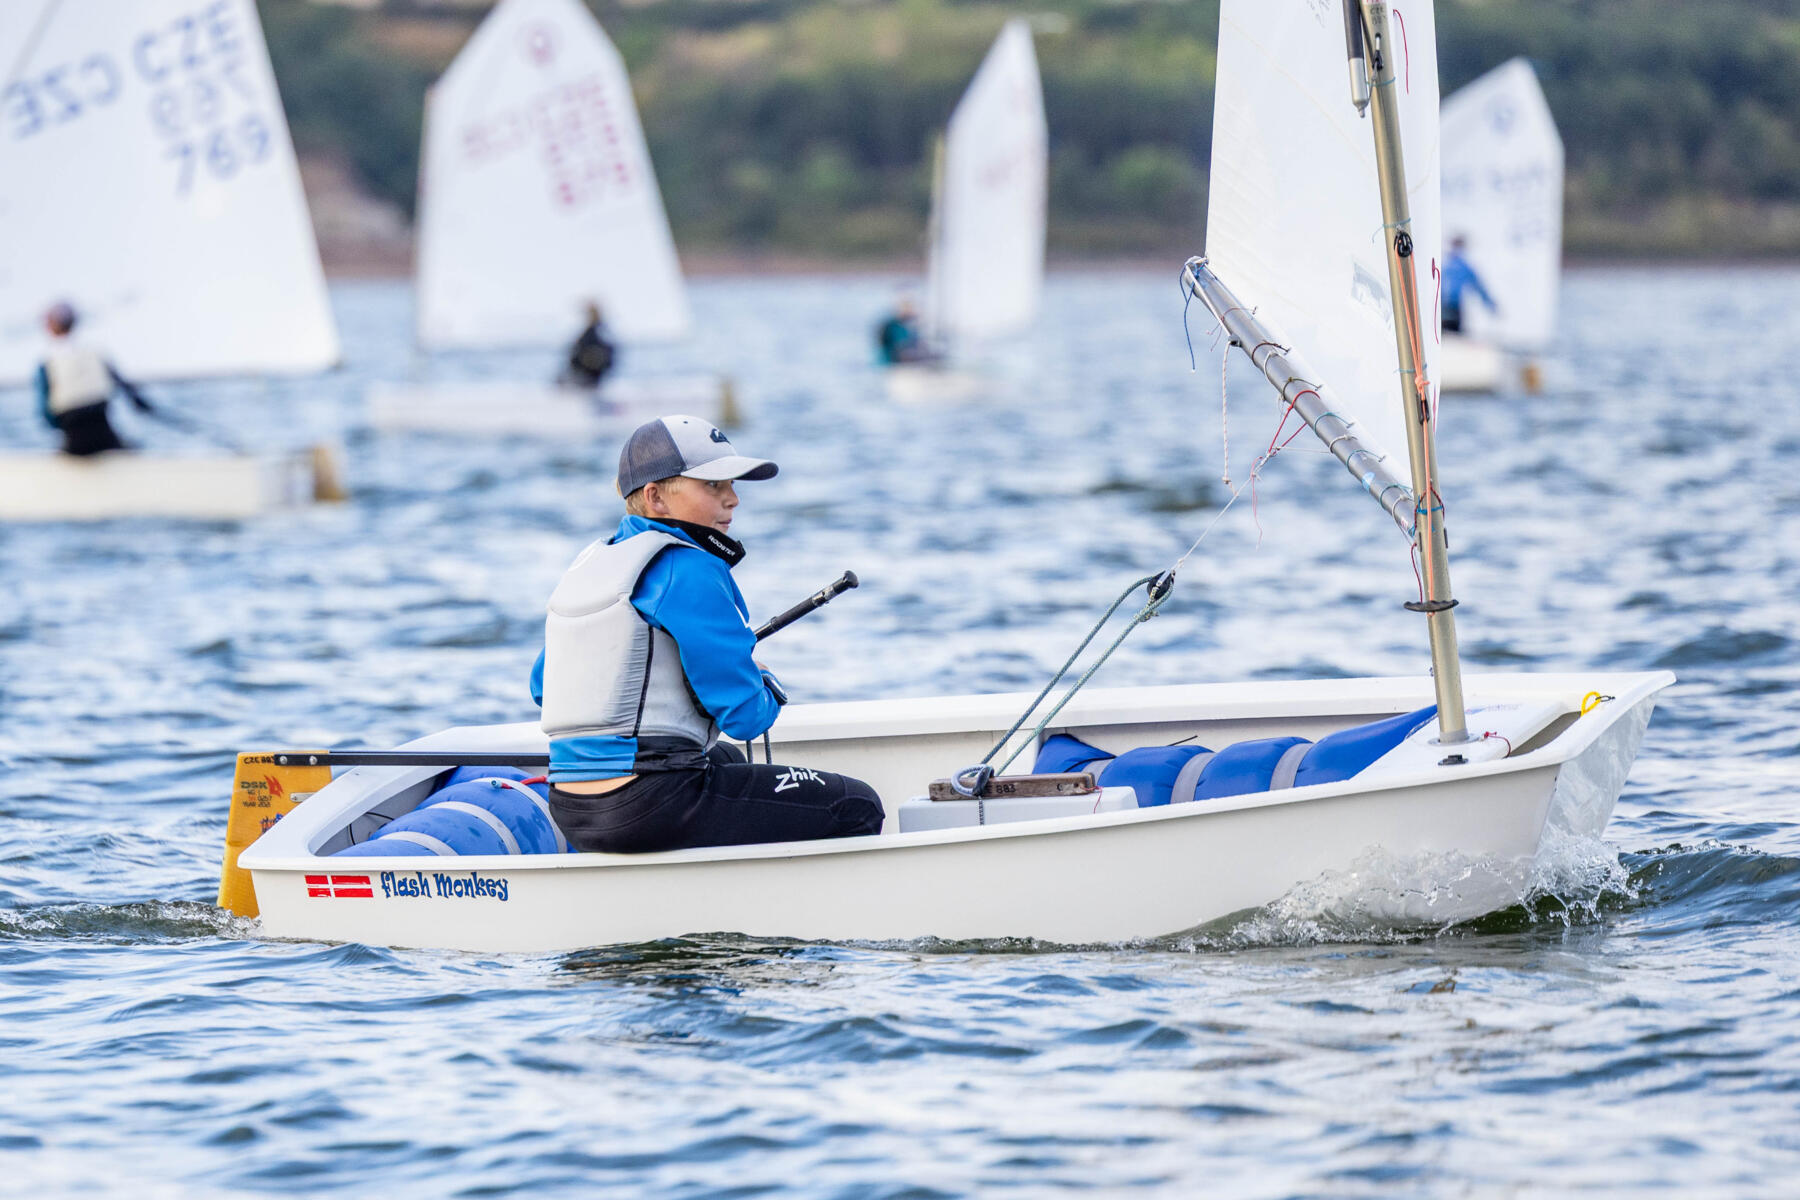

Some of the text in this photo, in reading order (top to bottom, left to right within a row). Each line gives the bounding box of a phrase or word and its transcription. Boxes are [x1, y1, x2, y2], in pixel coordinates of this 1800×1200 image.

[161, 112, 273, 201] 769
[708, 535, 736, 556] ROOSTER
[240, 781, 268, 790] DSK
[996, 784, 1016, 794] 883
